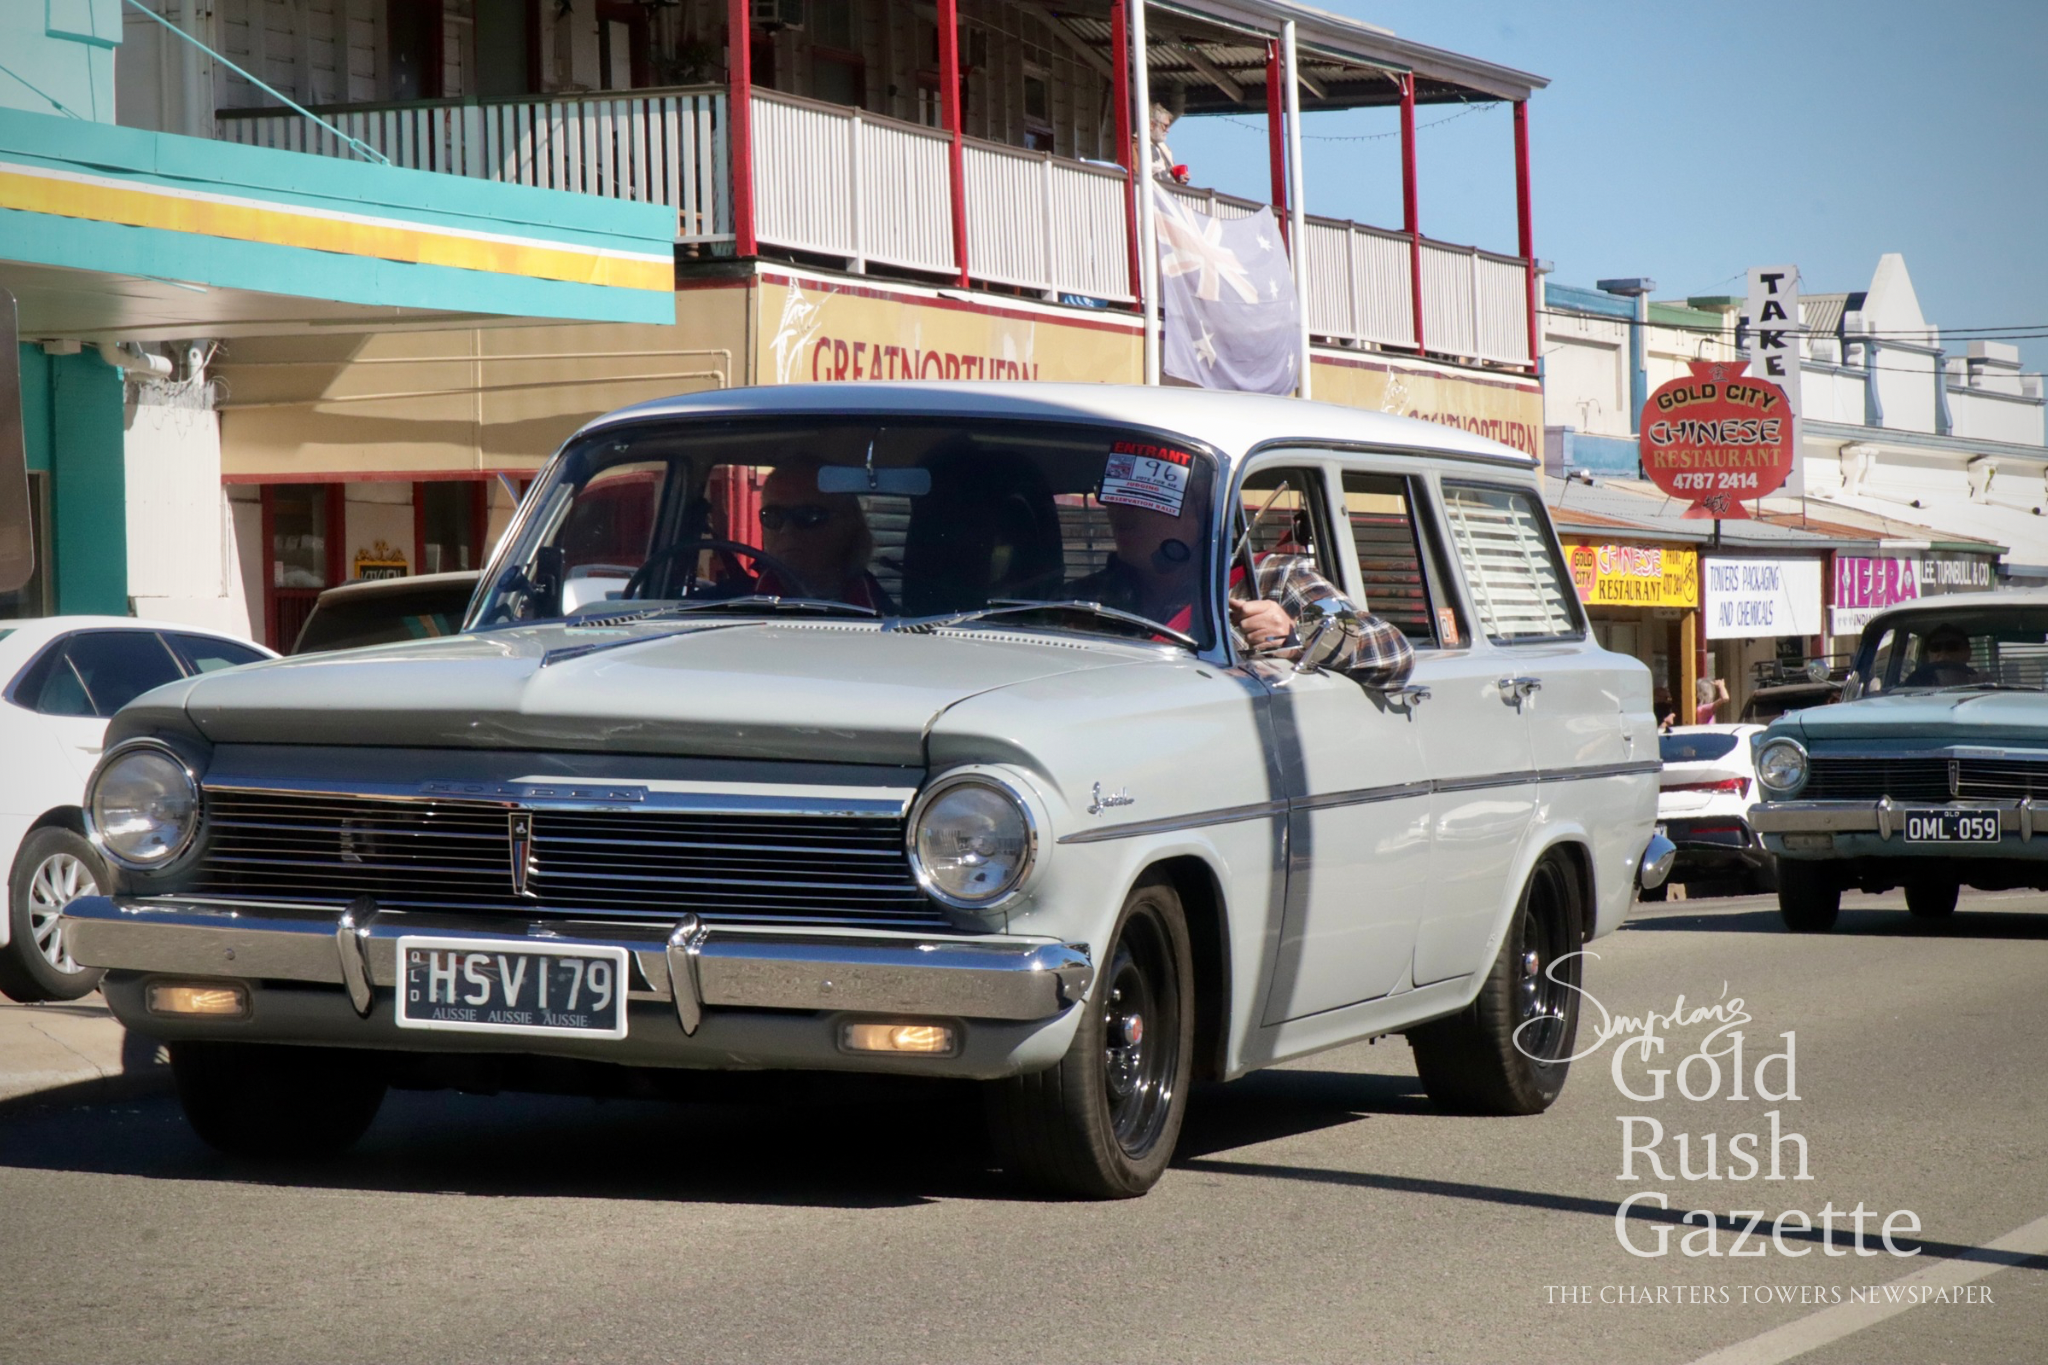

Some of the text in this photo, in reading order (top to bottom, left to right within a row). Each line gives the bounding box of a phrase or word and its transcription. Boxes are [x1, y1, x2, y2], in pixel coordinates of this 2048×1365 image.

[1657, 384, 1778, 412] GOLD CITY
[1649, 418, 1782, 446] CHINESE
[1115, 442, 1191, 465] ENTRANT
[1653, 448, 1782, 469] RESTAURANT
[1146, 460, 1177, 482] 96
[1673, 472, 1758, 489] 4787 2414
[1126, 481, 1160, 492] JUDGING
[1104, 495, 1154, 507] OBSERVATION
[1155, 503, 1177, 514] RALLY
[1575, 552, 1593, 567] GOLD
[1598, 542, 1662, 577] CHINESE
[1575, 570, 1592, 587] CITY
[1710, 565, 1739, 592] TOWERS
[1742, 565, 1779, 592] PACKAGING
[1836, 557, 1918, 608] HEERA
[1937, 560, 1971, 586] TURNBULL
[1973, 561, 1978, 585] &
[1978, 562, 1990, 586] CO
[1599, 579, 1661, 601] RESTAURANT
[1718, 600, 1774, 627] AND CHEMICALS
[429, 783, 632, 799] HOLDEN
[410, 951, 420, 1002] QLD
[432, 1007, 588, 1027] AUSSIE AUSSIE AUSSIE
